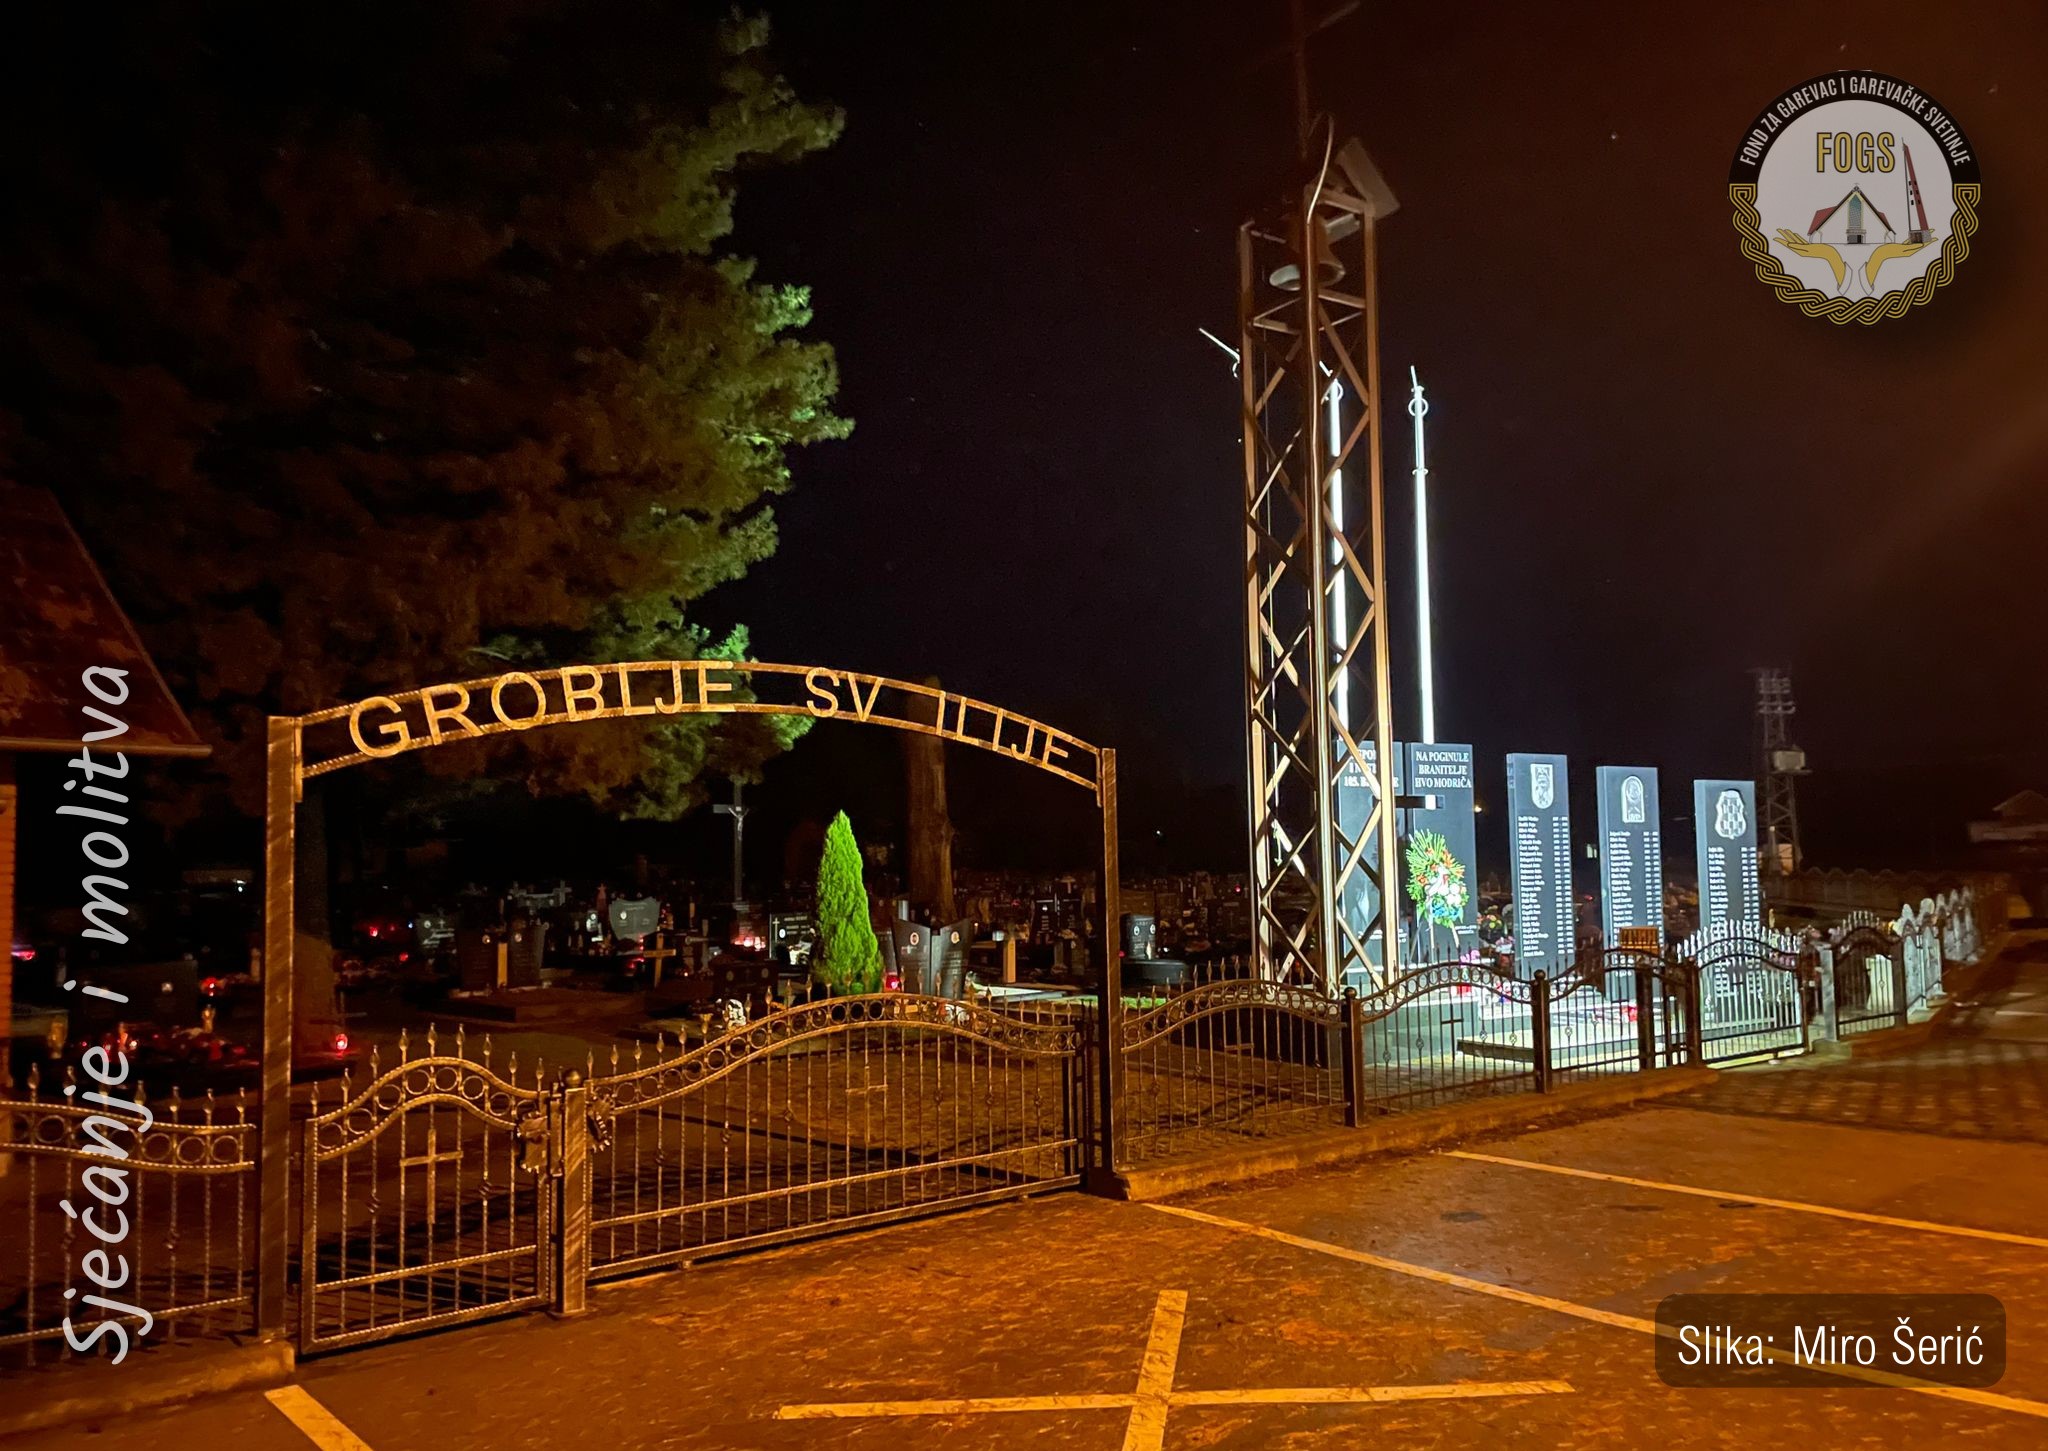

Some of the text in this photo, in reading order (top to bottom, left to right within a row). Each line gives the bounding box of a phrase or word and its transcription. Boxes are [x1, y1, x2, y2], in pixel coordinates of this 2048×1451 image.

[349, 660, 1075, 776] GROBLJE SV ILIJE
[1416, 751, 1470, 762] NA POGINULE
[1418, 764, 1468, 775] BRANITELJE
[1415, 776, 1472, 788] HVO MODRIČA
